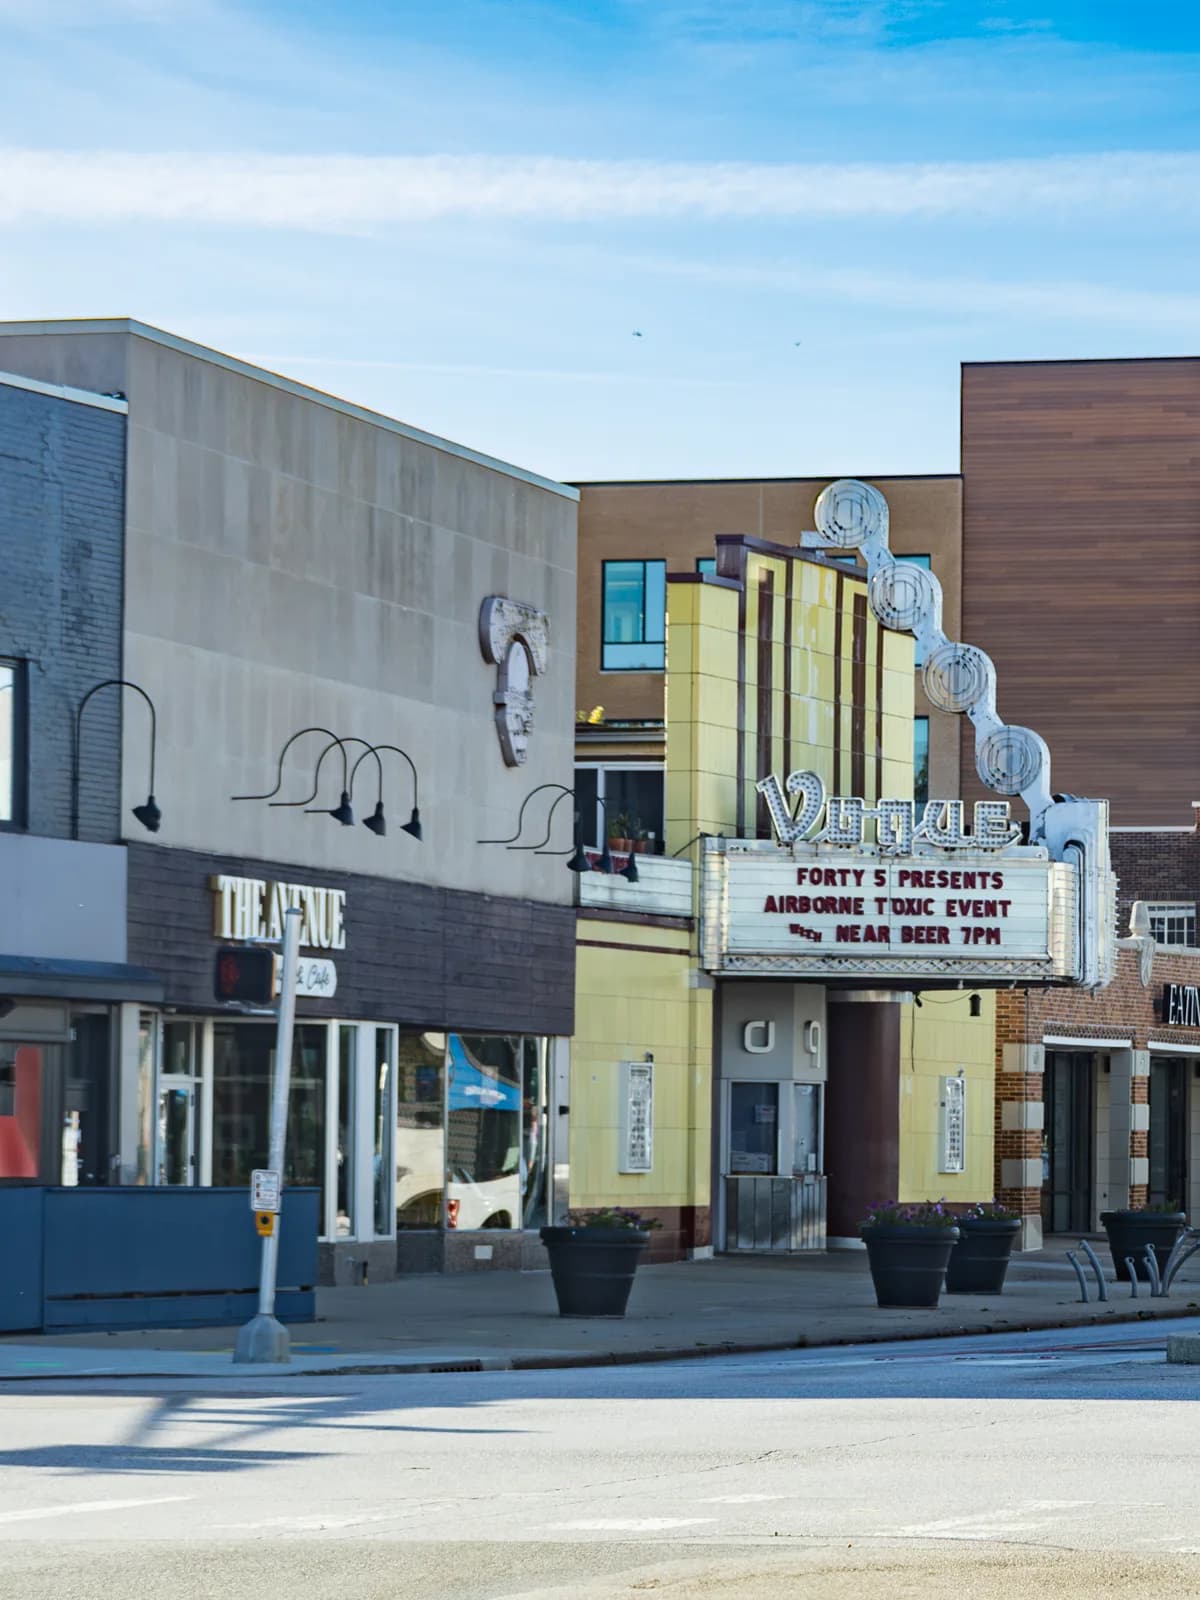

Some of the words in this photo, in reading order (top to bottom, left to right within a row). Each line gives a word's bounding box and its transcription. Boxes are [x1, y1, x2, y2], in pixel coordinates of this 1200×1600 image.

[797, 867, 865, 887] FORTY
[874, 869, 886, 887] 5
[898, 869, 1004, 890] PRESENTS
[216, 874, 267, 940] THE
[763, 895, 864, 915] AIRBORNE
[946, 899, 1012, 918] EVENT
[836, 924, 891, 943] NEAR
[901, 925, 950, 945] BEER
[960, 926, 1001, 945] 7PM
